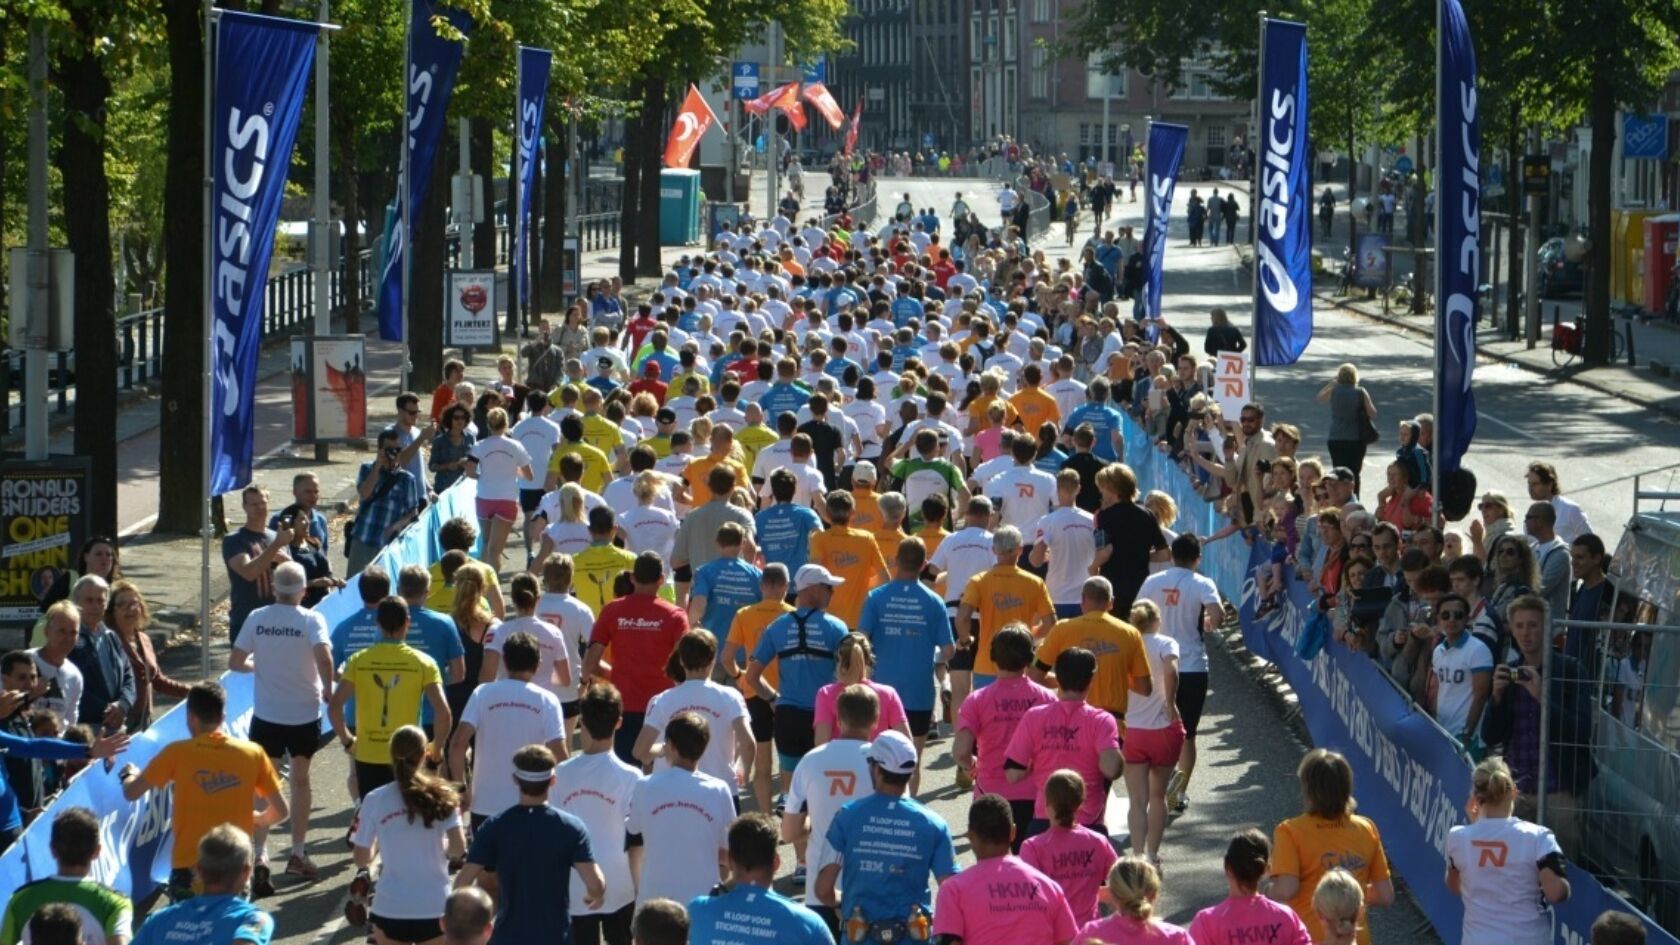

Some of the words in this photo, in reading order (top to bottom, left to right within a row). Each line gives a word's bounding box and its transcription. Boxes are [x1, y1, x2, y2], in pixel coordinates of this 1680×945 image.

[1260, 88, 1296, 240] asics
[218, 104, 270, 318] asics
[135, 781, 173, 848] asic
[651, 800, 715, 822] www.hema.nl
[859, 859, 884, 873] IBM
[715, 920, 750, 935] STICHTING
[731, 911, 751, 922] LOOP
[751, 915, 771, 925] VOOR
